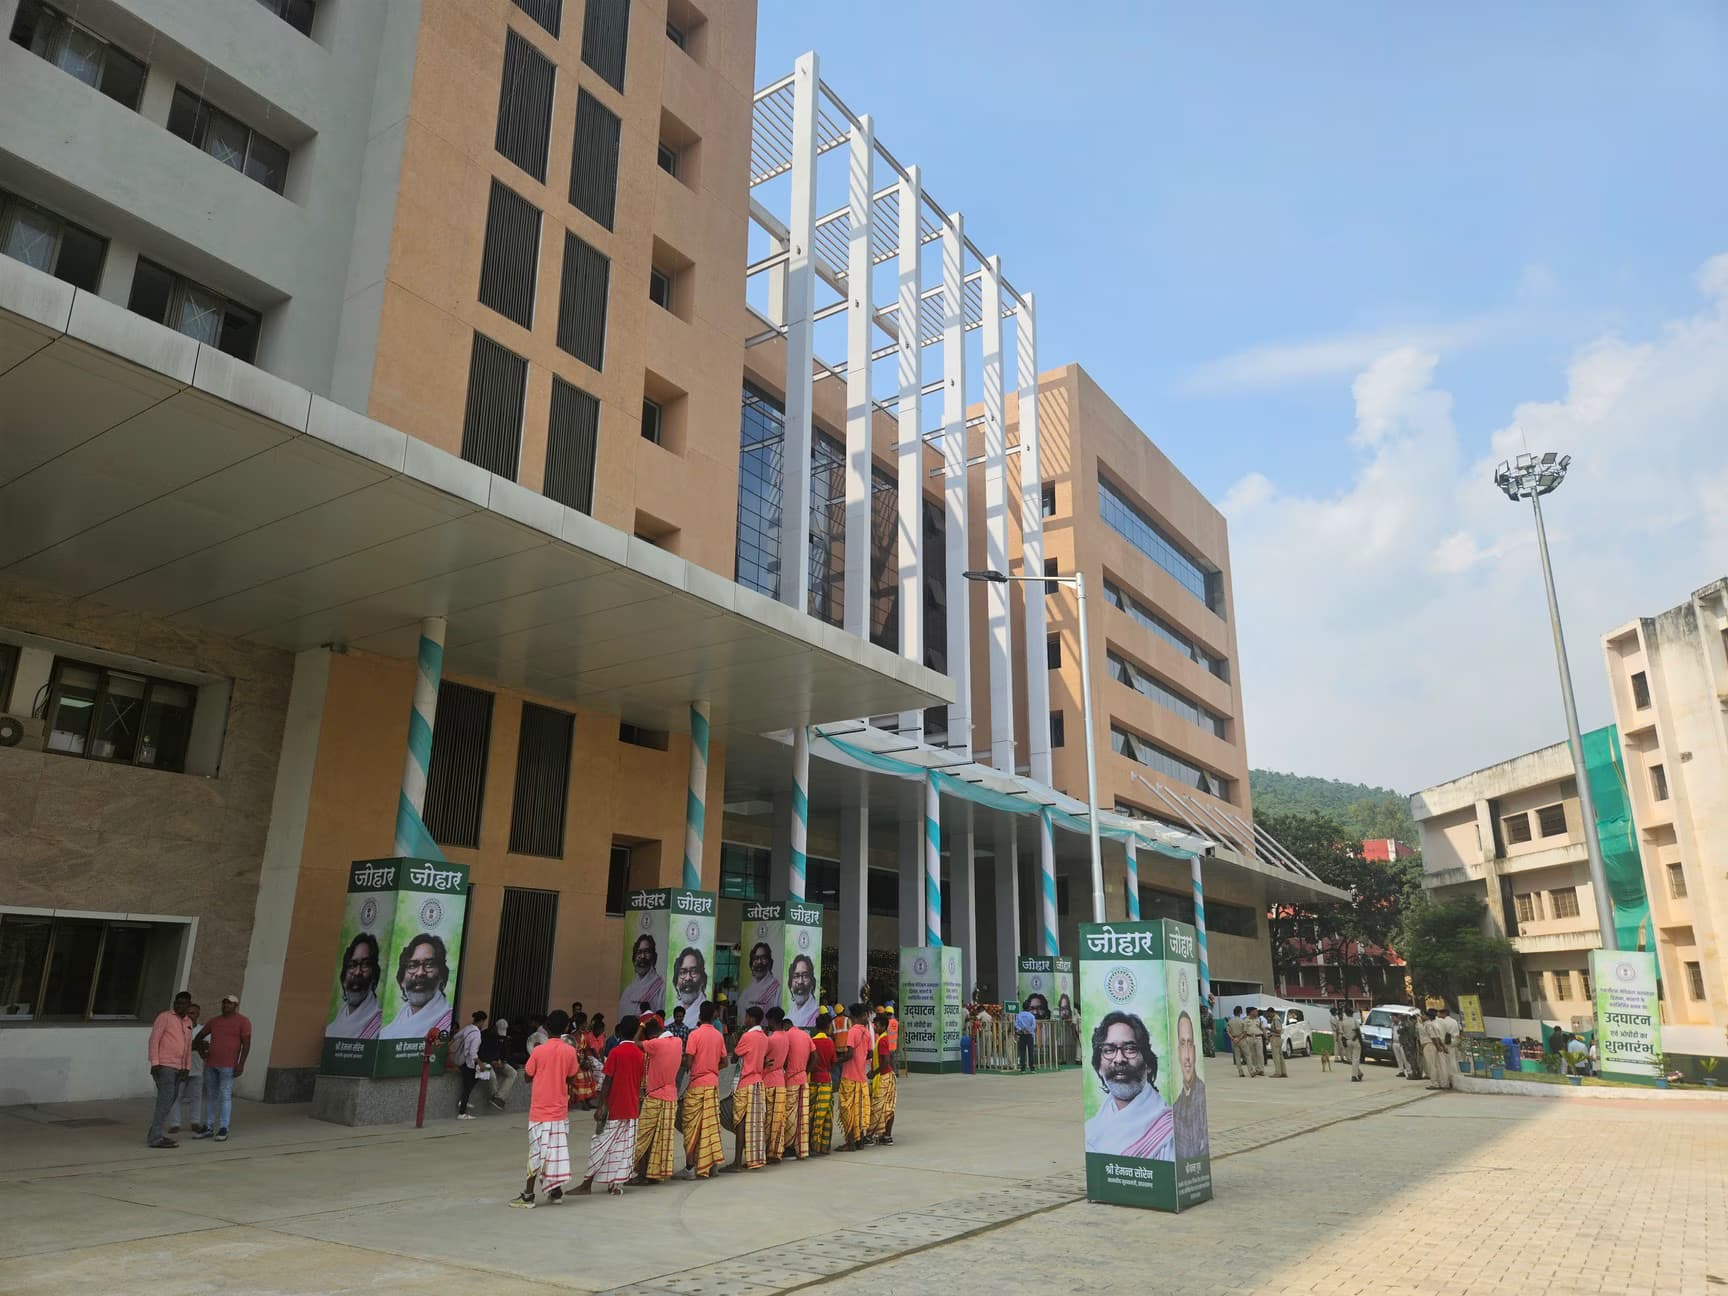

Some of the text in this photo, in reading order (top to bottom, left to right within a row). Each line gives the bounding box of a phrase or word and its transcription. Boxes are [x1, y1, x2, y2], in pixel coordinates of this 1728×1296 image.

[355, 863, 395, 887] जोहार
[410, 863, 463, 890] जोहार
[631, 889, 666, 908] जोहार
[677, 892, 712, 913] जोहार
[747, 903, 781, 921] जोहार
[790, 905, 820, 924] जोहार
[1087, 925, 1153, 956] जोहार
[1169, 926, 1193, 959] जोहार
[1022, 958, 1050, 972] जोहार
[1604, 1012, 1652, 1027] उद्घाटन
[1604, 1040, 1654, 1055] शुभारंभ
[1105, 1163, 1114, 1175] श्री
[1134, 1166, 1153, 1180] सोरेन
